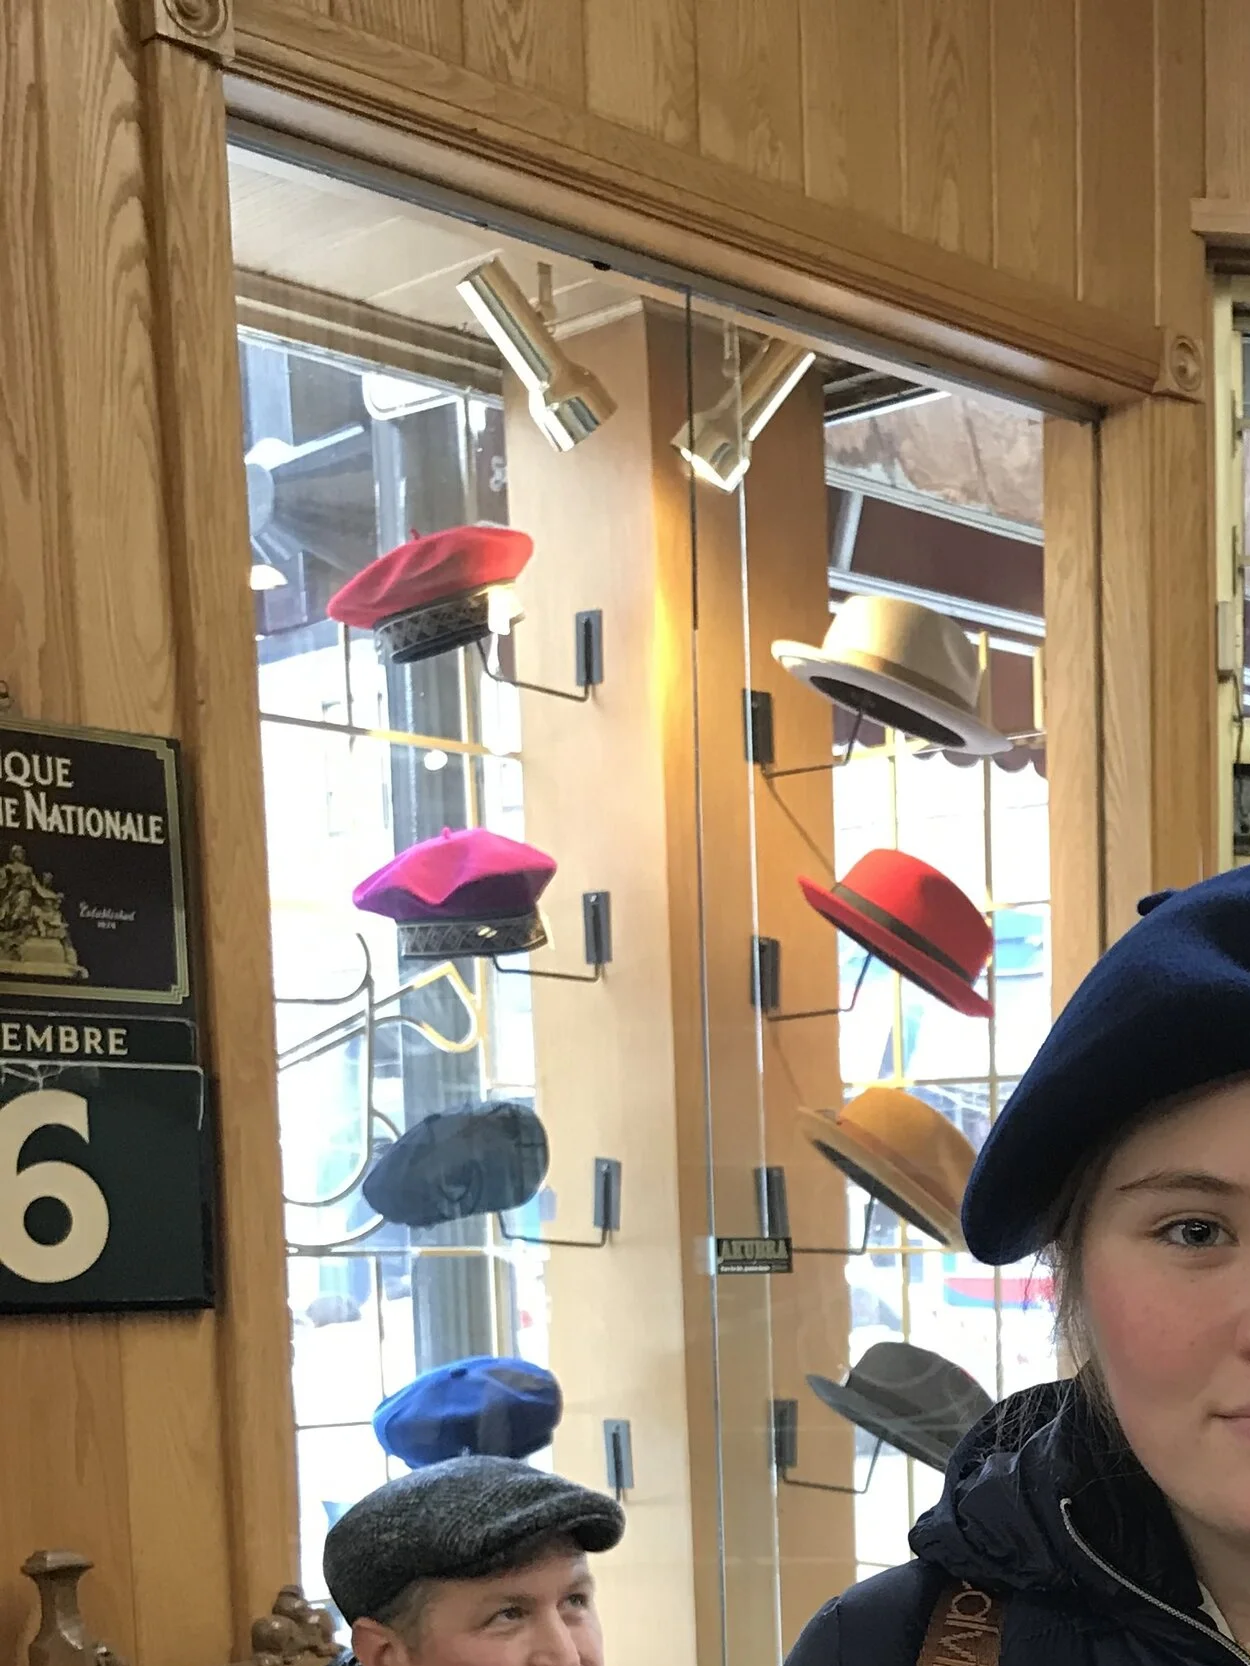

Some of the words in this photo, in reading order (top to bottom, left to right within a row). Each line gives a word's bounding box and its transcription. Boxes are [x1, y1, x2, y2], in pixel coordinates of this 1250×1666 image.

[0, 751, 75, 789] QUE
[24, 789, 166, 845] NATIONALE
[1, 1022, 129, 1056] EMBRE
[0, 1088, 110, 1284] 6
